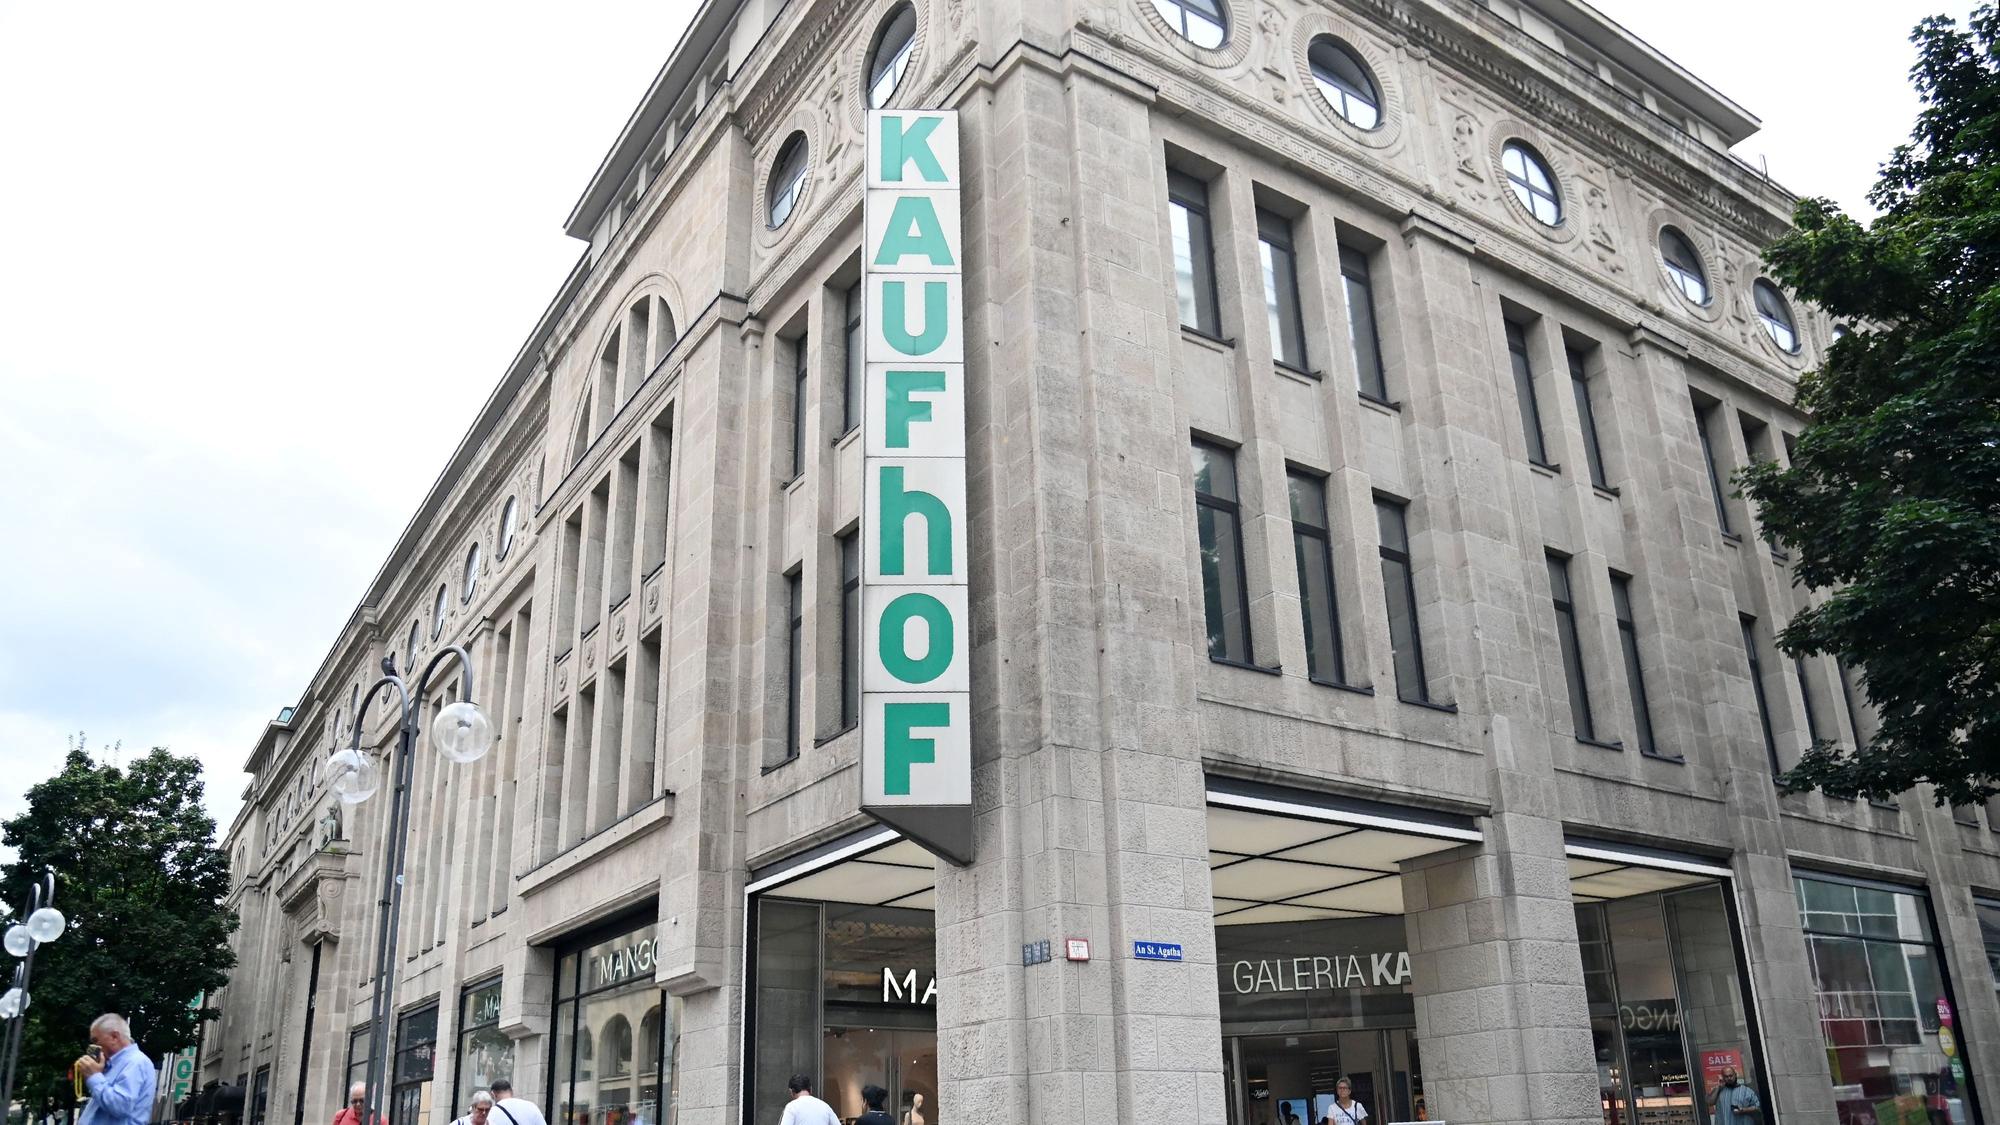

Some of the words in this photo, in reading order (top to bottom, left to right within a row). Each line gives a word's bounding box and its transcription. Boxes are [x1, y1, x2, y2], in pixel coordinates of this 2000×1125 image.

[873, 116, 956, 796] KAUFhOF
[1135, 945, 1145, 955] An
[1146, 945, 1156, 955] St.
[1157, 946, 1181, 959] Agatha
[1233, 955, 1367, 994] GALERIA
[1370, 951, 1412, 986] KA
[1708, 1055, 1732, 1065] SALE
